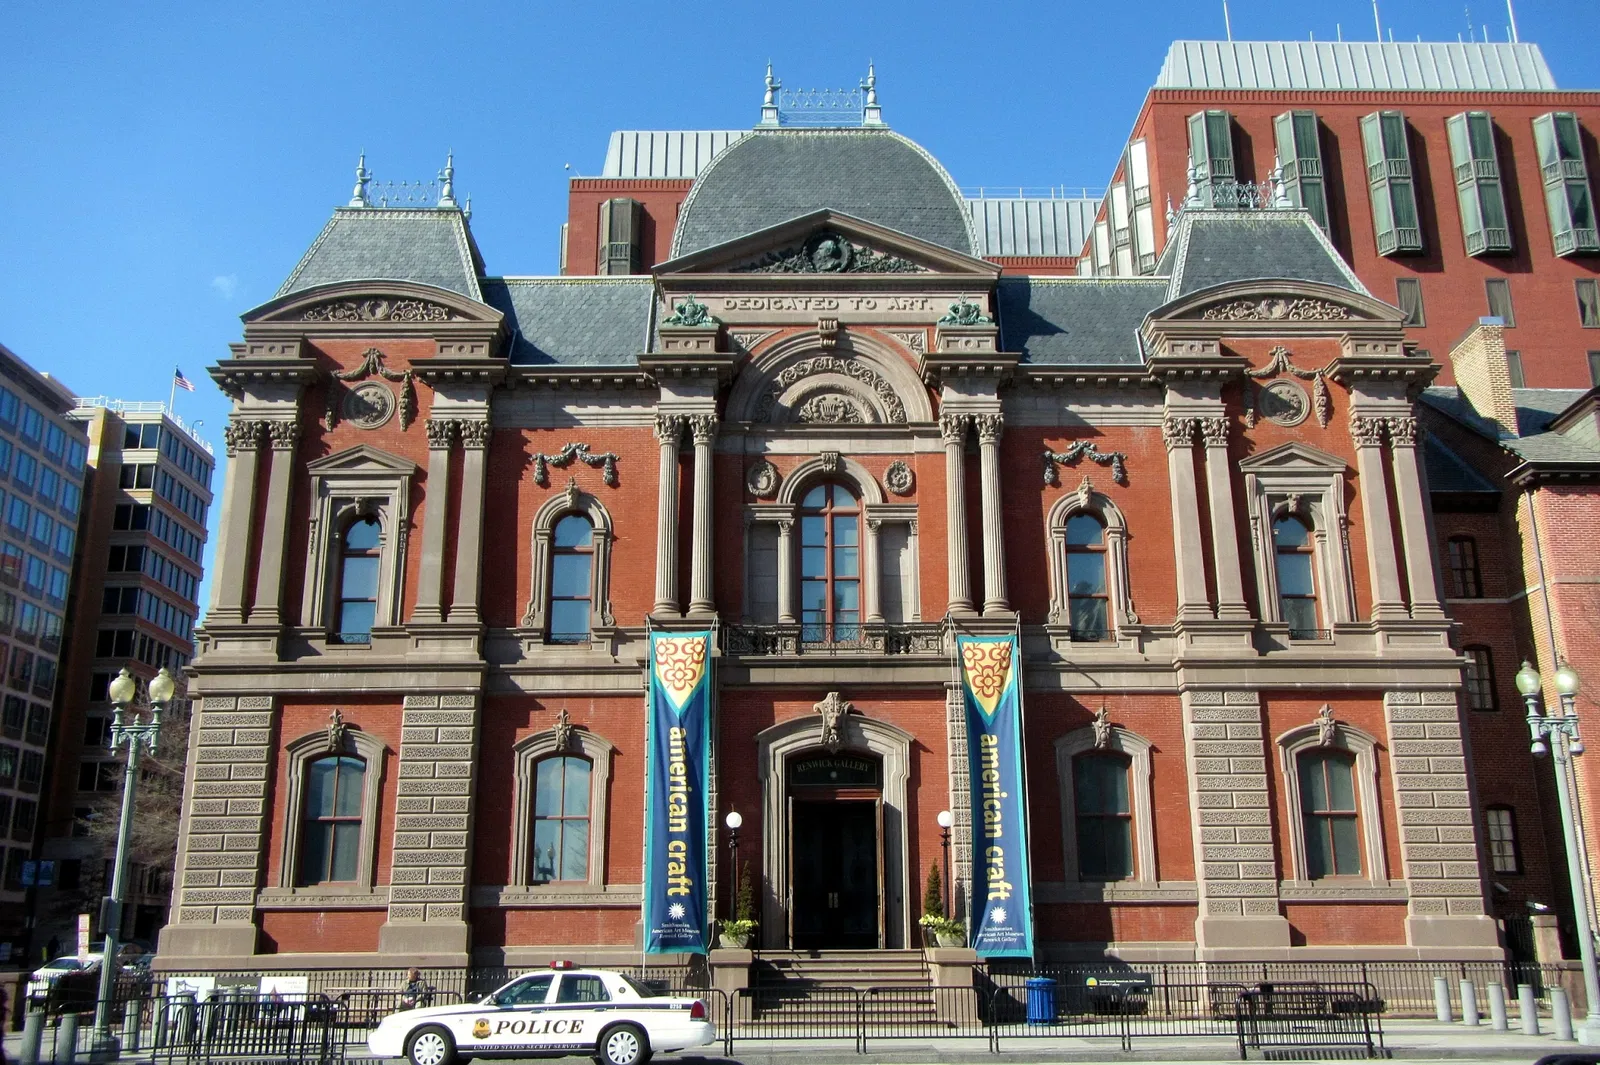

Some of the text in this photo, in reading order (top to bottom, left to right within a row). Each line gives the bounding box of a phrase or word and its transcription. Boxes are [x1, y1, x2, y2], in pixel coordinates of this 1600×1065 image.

[723, 298, 934, 311] DEDICATED TO ART.
[796, 759, 869, 773] RENWICK GALLERY
[667, 726, 692, 896] american craft
[980, 734, 1013, 901] american craft
[493, 1019, 585, 1035] POLICE
